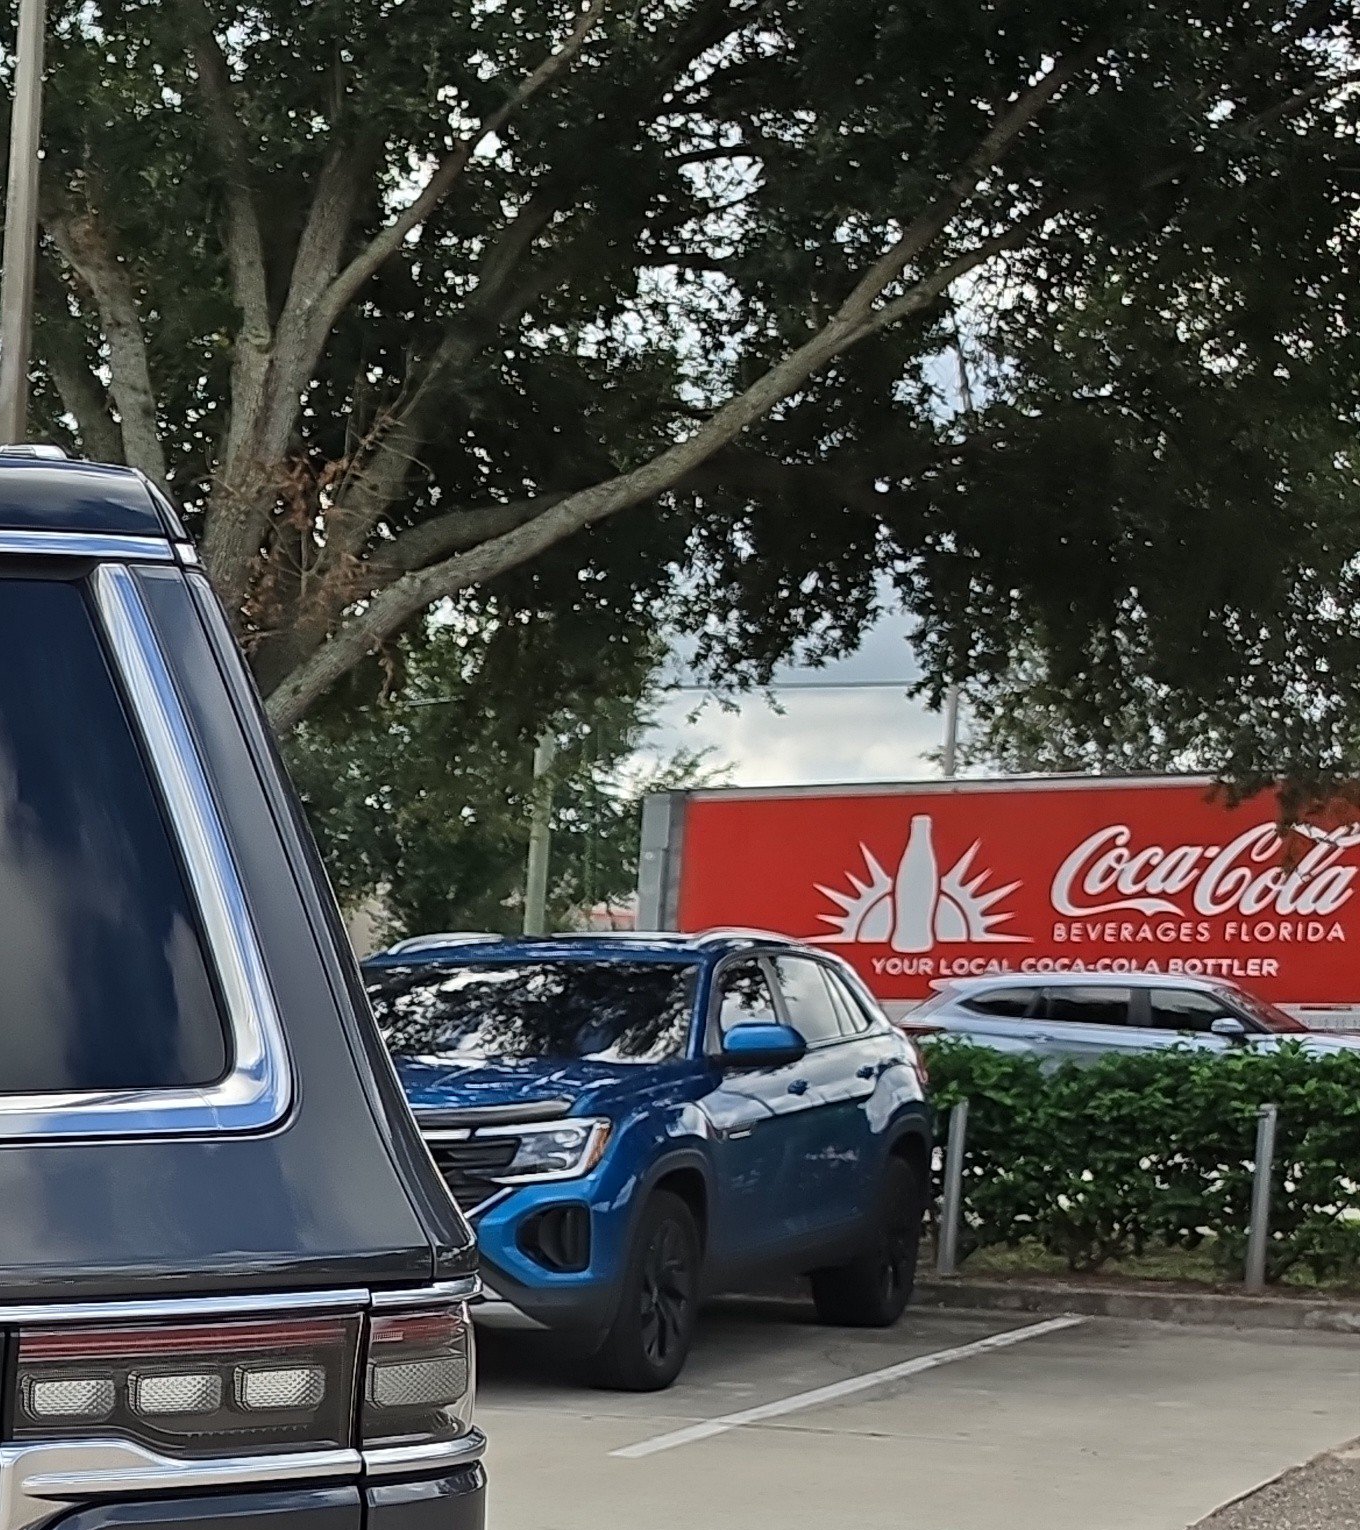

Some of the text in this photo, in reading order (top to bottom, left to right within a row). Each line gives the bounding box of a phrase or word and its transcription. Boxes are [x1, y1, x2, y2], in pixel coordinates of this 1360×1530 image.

[1051, 822, 1359, 916] Coca-Cola
[1053, 921, 1346, 943] BEVERAGES FLORIDA
[872, 957, 1279, 977] YOUR LOCAL COCA-COLA BOTTLER
